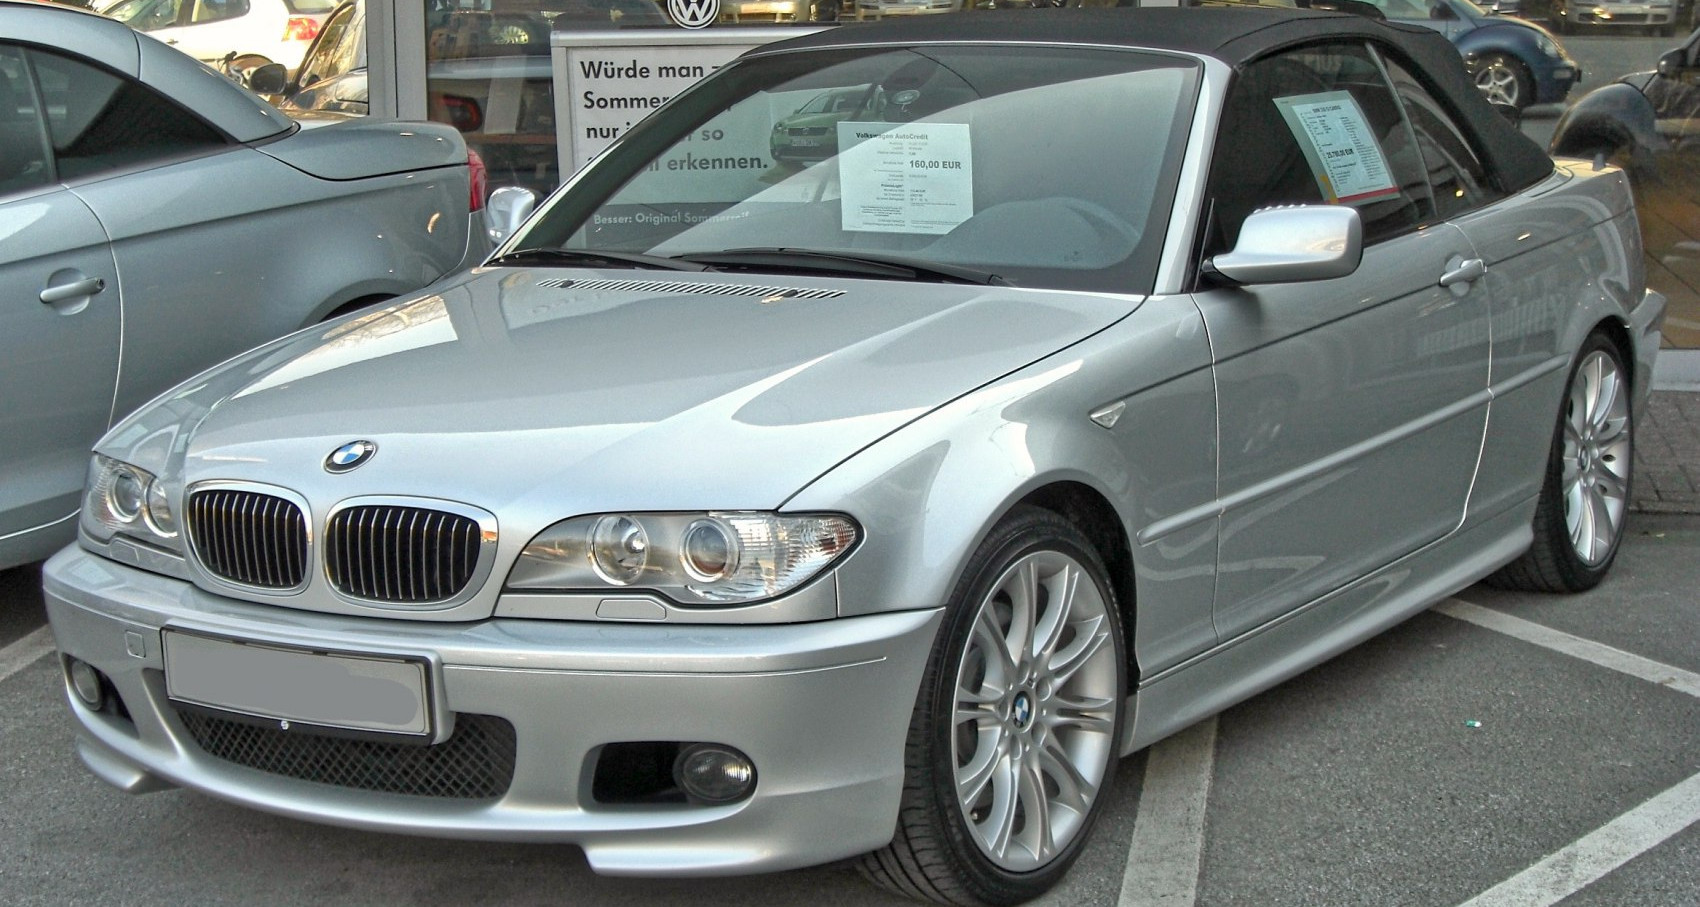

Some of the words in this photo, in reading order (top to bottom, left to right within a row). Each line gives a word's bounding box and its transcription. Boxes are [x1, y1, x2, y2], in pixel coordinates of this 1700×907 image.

[580, 60, 650, 79] Würde
[658, 65, 704, 78] man
[583, 91, 670, 109] Sommer
[586, 127, 619, 139] nur
[702, 129, 724, 141] so
[667, 153, 768, 171] erkennen.
[909, 160, 940, 170] 160,00
[942, 160, 962, 170] EUR
[593, 214, 632, 225] Besser:
[635, 212, 681, 226] Original
